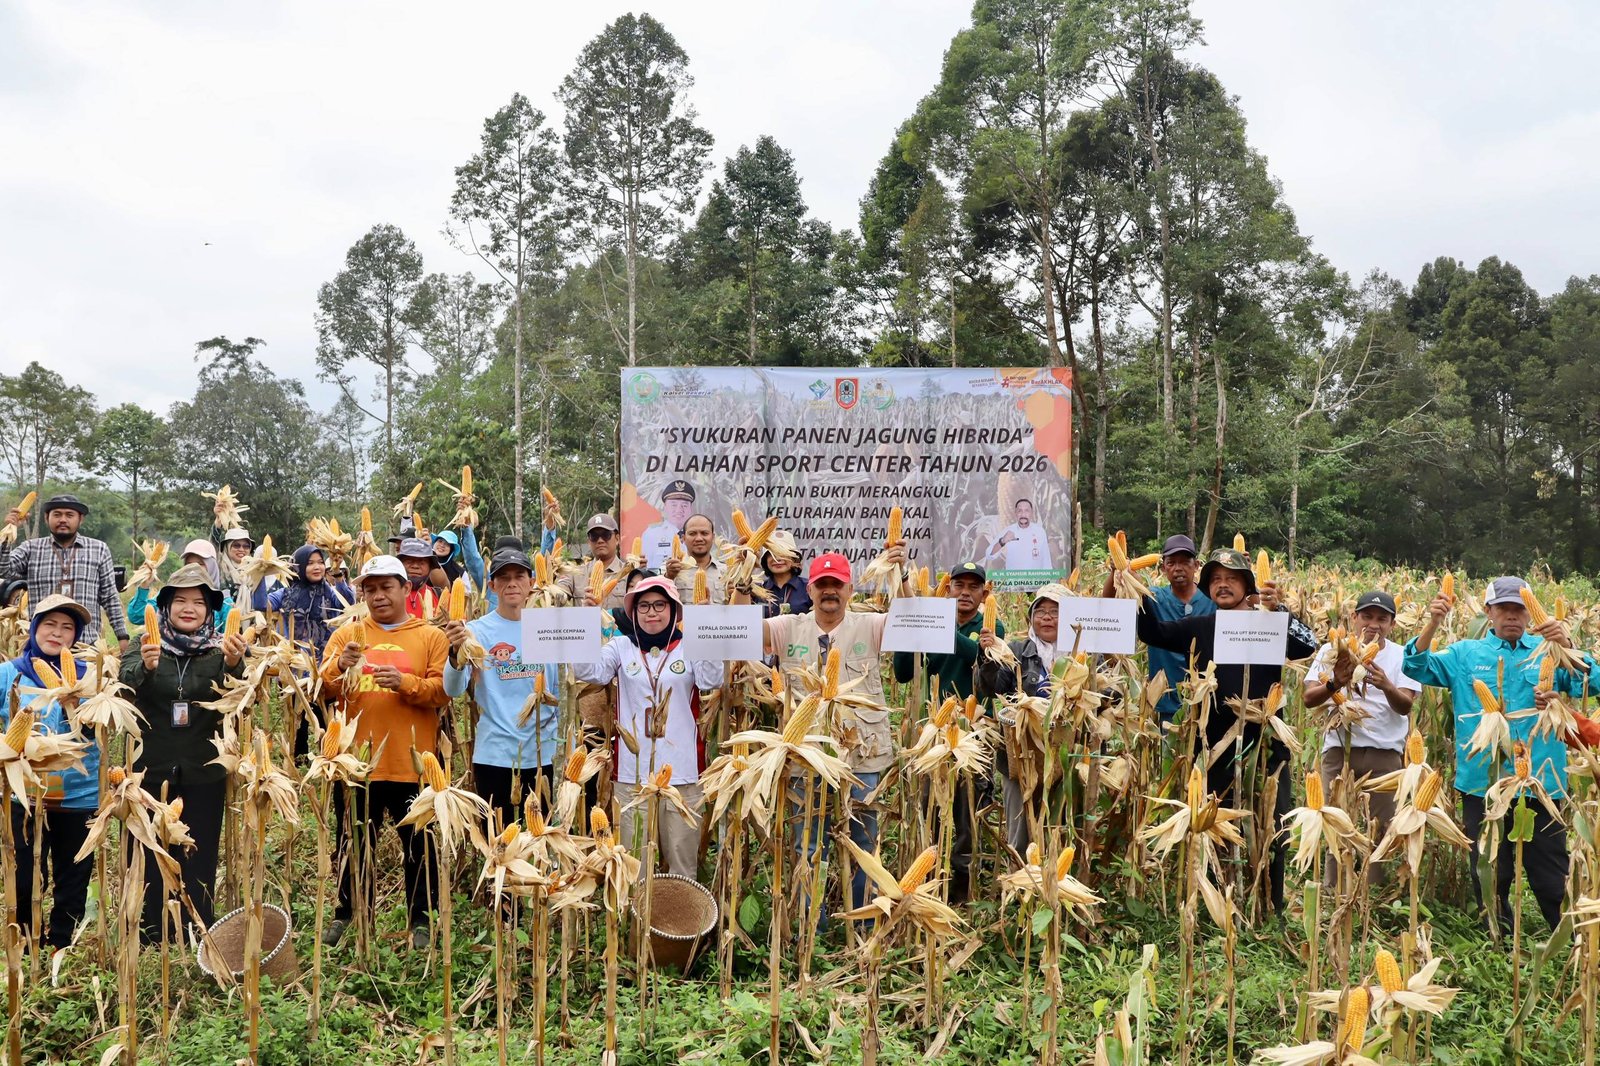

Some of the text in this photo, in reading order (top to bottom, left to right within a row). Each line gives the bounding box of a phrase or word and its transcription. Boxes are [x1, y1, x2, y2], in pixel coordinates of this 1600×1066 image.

[782, 427, 852, 444] PANEN
[854, 428, 937, 448] JAGUNG
[646, 455, 1048, 472] DI LAHAN SPORT CENTER TAHUN 2026
[744, 486, 951, 498] POKTAN BUKIT MERANGKUL
[766, 506, 930, 518] KELURAHAN BANKAL
[861, 528, 931, 540] CEMAKA
